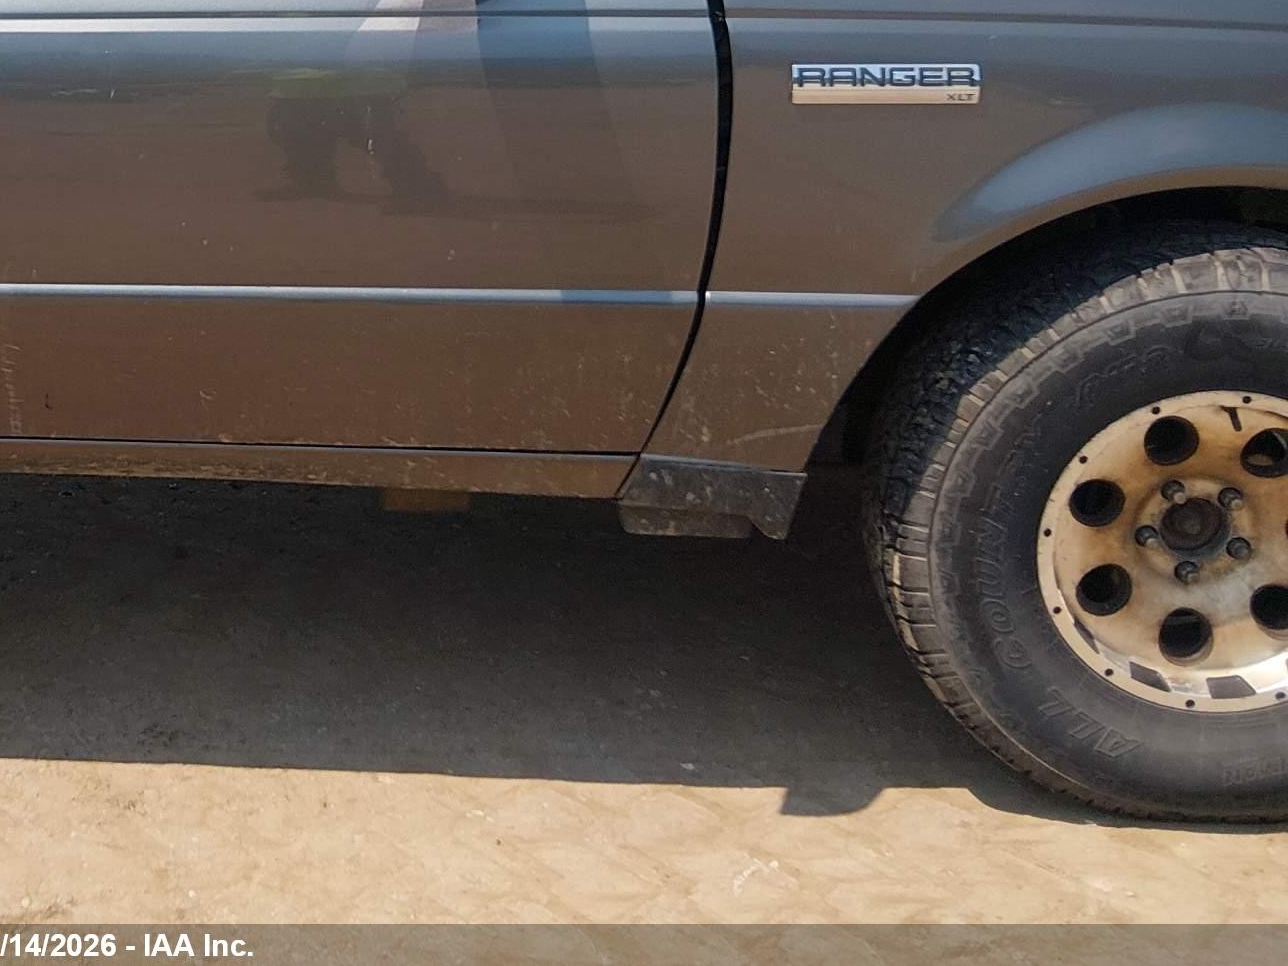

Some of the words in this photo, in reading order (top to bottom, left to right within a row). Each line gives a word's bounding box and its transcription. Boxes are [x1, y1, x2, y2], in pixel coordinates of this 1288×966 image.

[795, 66, 981, 88] RANGER
[946, 93, 976, 102] XLT
[1039, 687, 1140, 762] ALL
